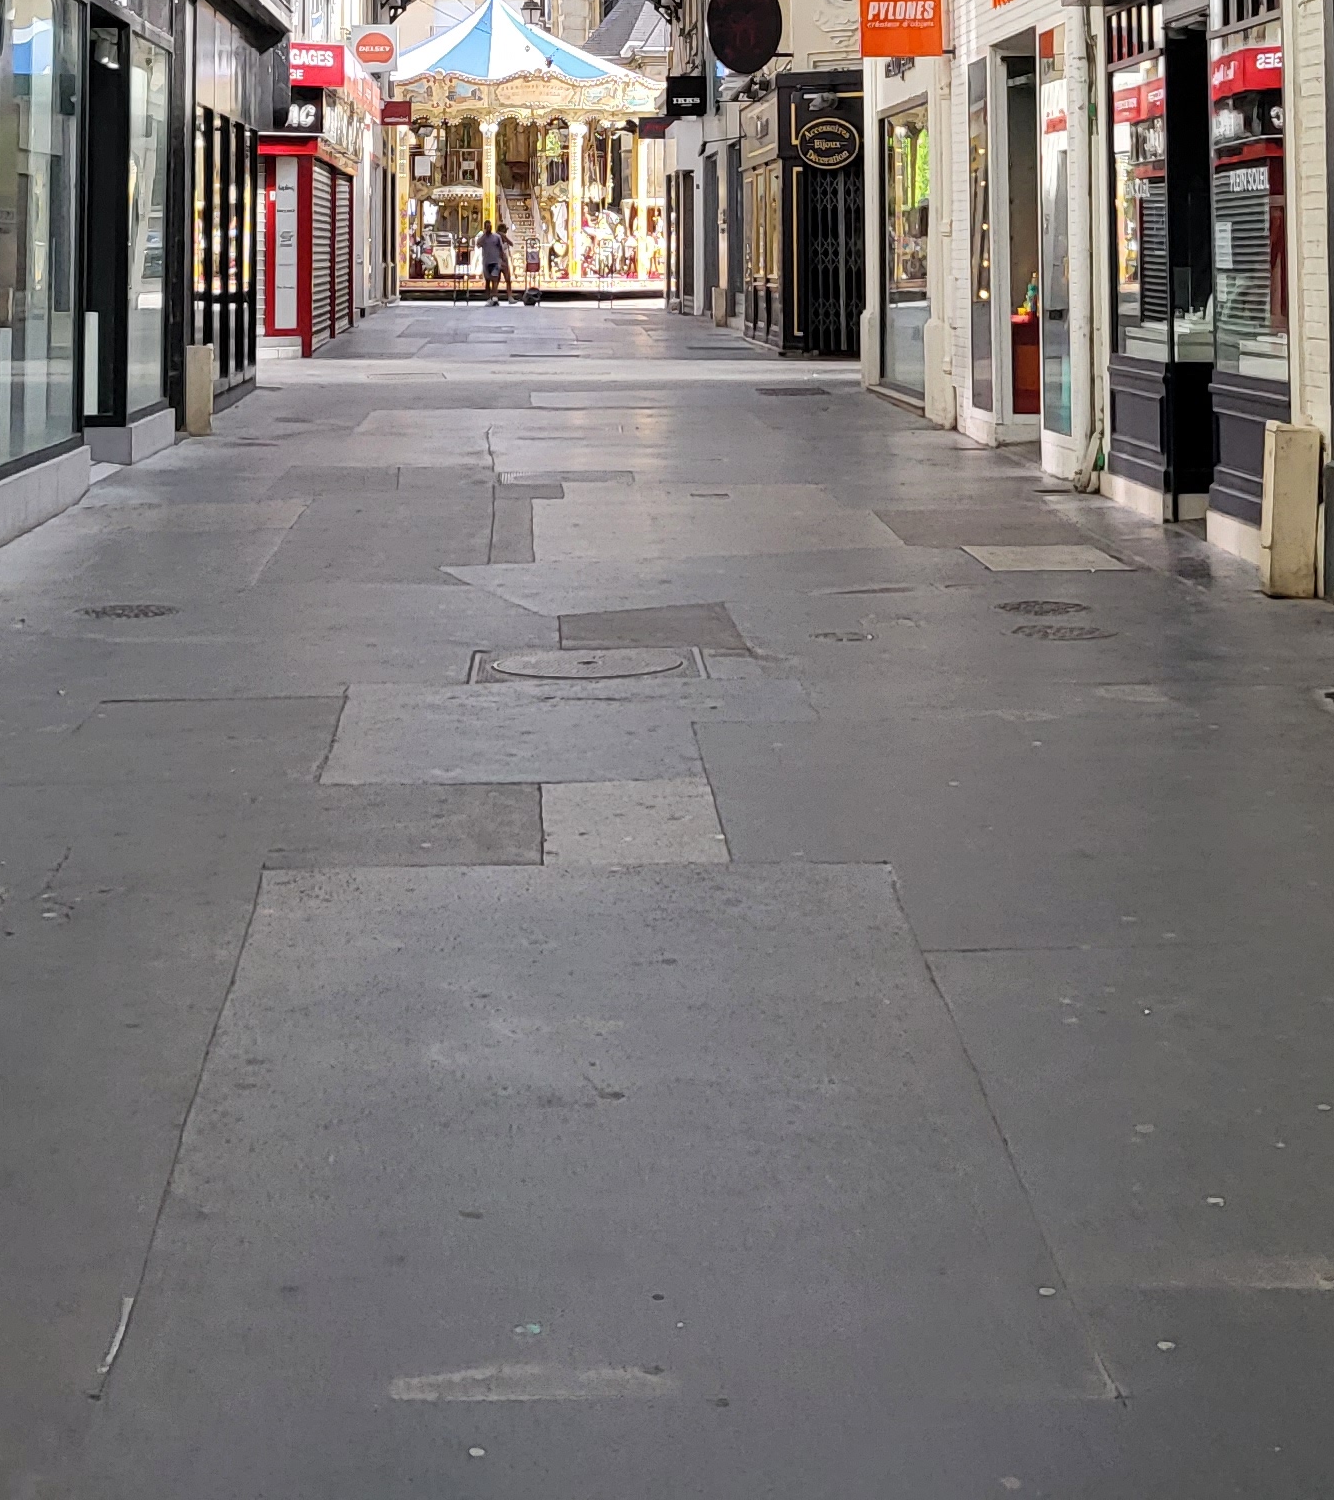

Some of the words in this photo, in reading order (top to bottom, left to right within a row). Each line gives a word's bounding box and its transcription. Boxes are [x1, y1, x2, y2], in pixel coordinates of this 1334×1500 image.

[867, 1, 934, 20] PYLONES
[805, 125, 850, 140] Accessoires
[814, 139, 841, 150] Bijoux
